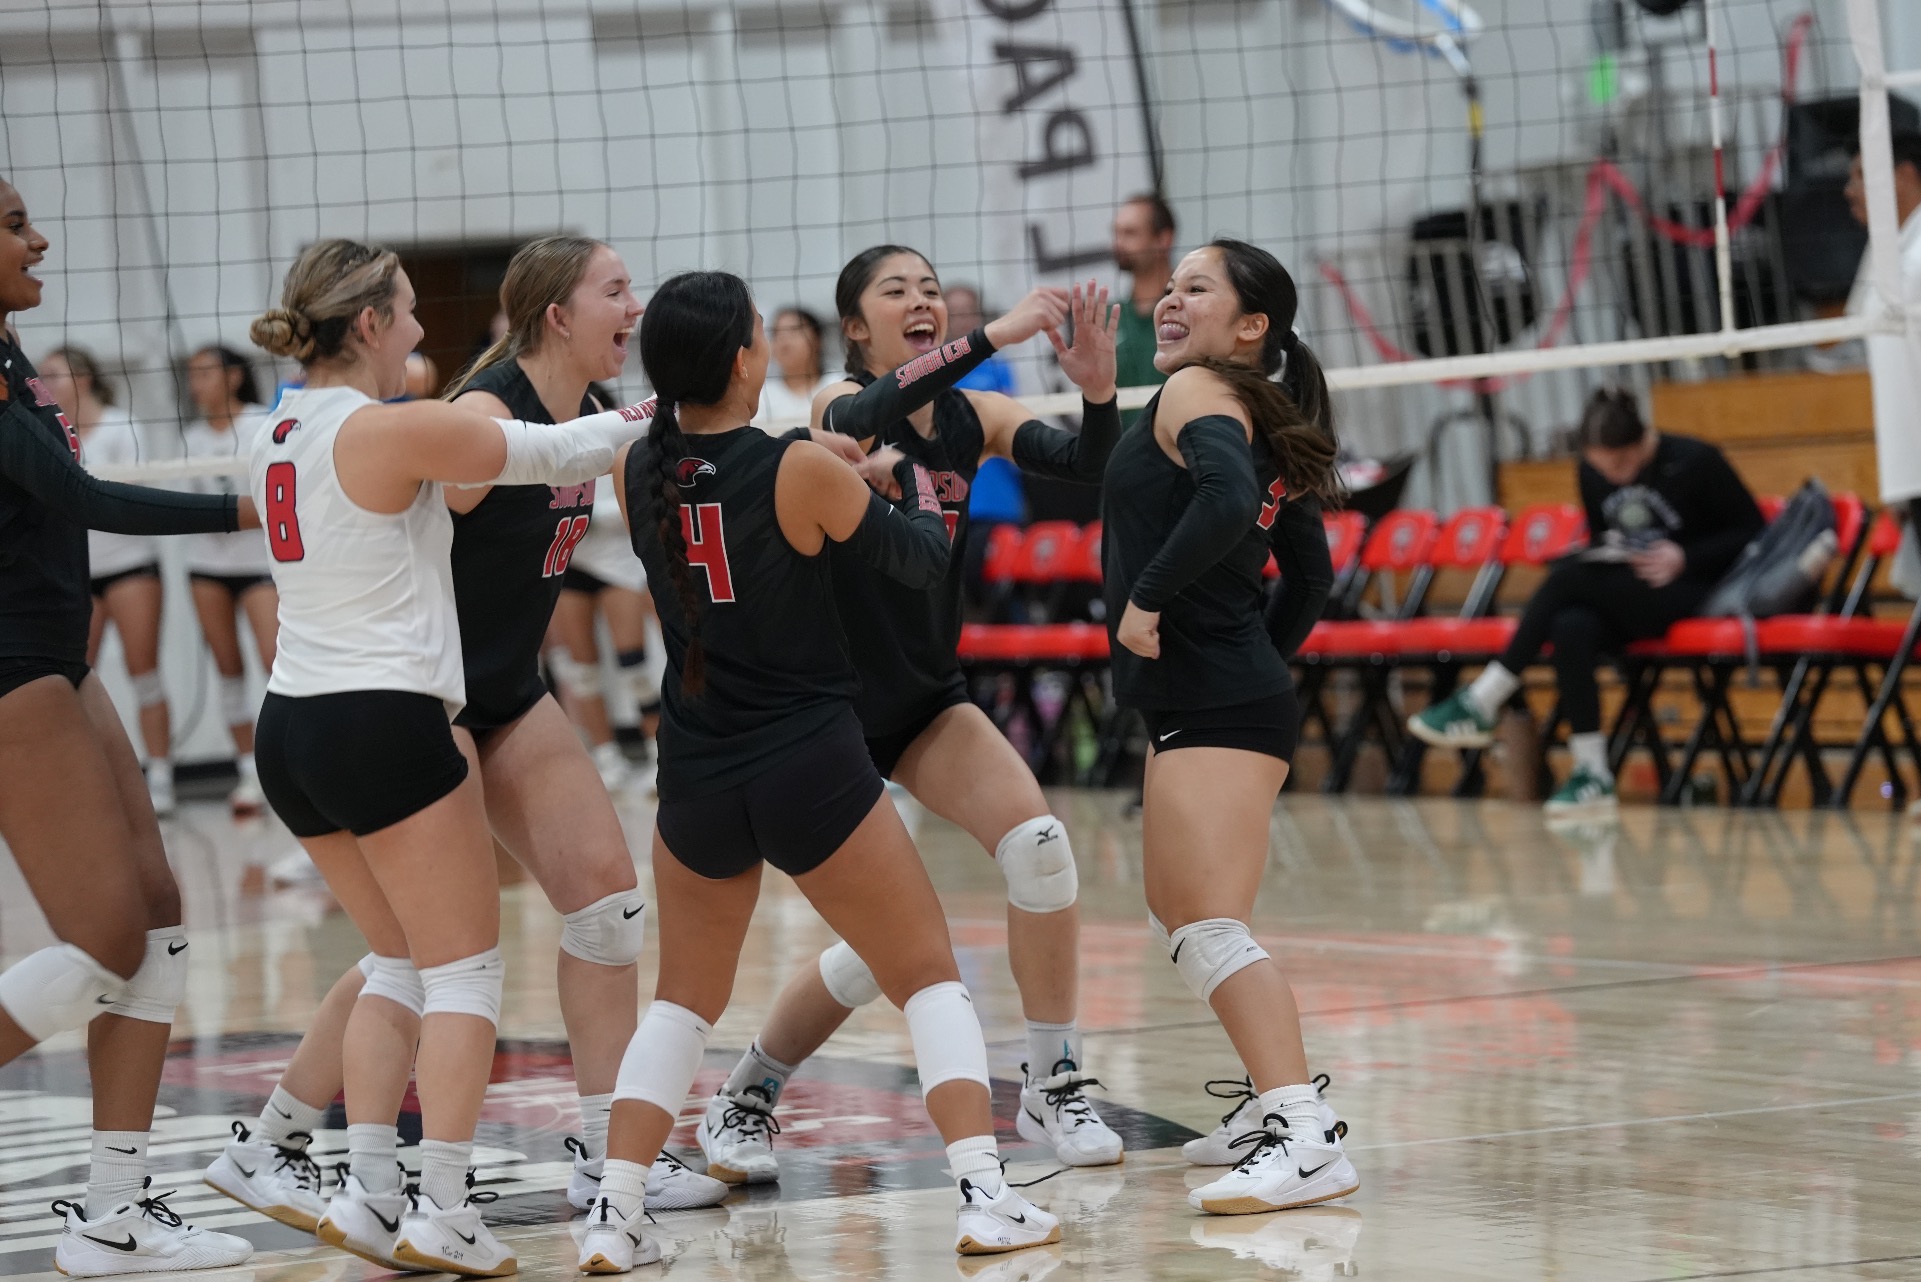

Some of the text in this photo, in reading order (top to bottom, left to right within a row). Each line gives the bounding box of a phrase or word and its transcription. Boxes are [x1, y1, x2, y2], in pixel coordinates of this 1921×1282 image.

[266, 462, 304, 562] 8
[542, 514, 589, 578] 18
[680, 503, 736, 603] 4
